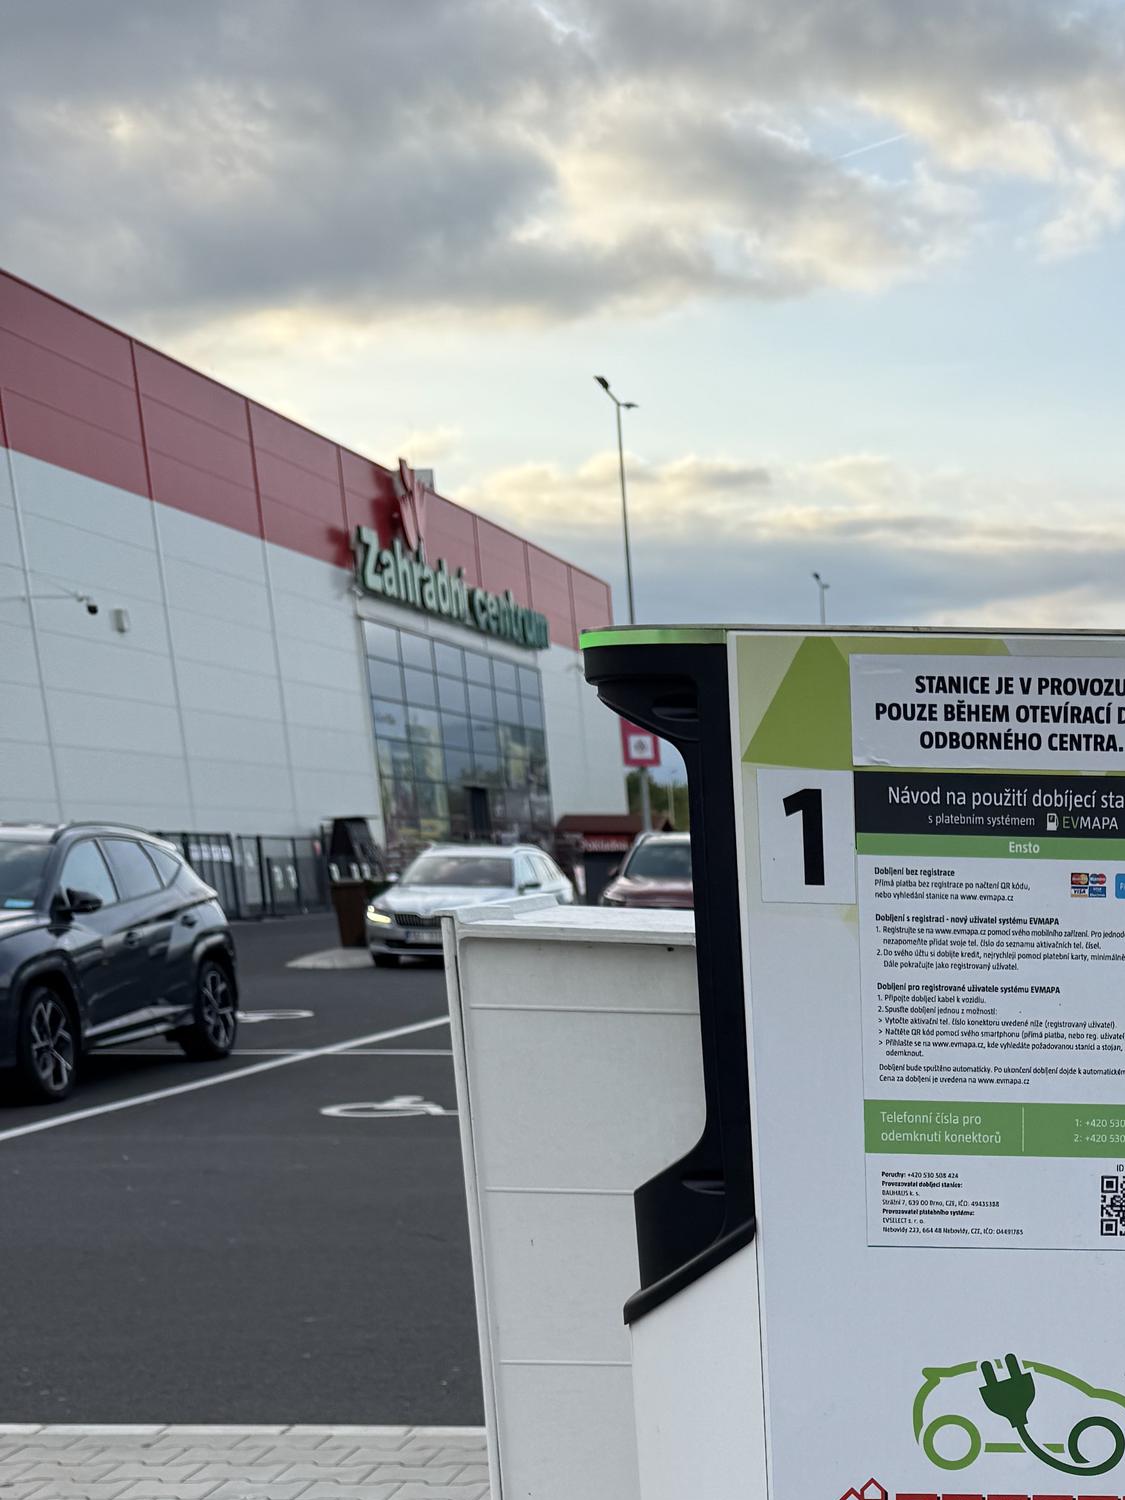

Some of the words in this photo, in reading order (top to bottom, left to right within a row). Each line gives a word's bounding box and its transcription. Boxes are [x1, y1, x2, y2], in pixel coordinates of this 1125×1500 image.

[356, 526, 472, 626] Zahradní
[915, 675, 990, 695] STANICE
[995, 676, 1014, 695] JE
[1019, 677, 1032, 695] V
[875, 702, 938, 722] POUZE
[944, 699, 1010, 723] BĚHEM
[1015, 700, 1113, 724] OTEVÍRACÍ
[920, 728, 1042, 751] ODBORNÉHO
[1048, 733, 1124, 752] CENTRA.
[888, 785, 940, 805] Návod
[946, 791, 966, 805] na
[972, 787, 1028, 811] použití
[1032, 788, 1097, 812] dobíjecí
[928, 815, 933, 824] s
[935, 813, 984, 827] platebním
[987, 814, 1035, 828] systémem
[1063, 815, 1119, 830] EVMAPA
[783, 789, 825, 885] 1
[1009, 841, 1040, 854] Ensto
[874, 866, 904, 877] Dobíjení
[905, 867, 919, 876] bez
[919, 868, 955, 878] registrace
[874, 879, 894, 887] Přímá
[896, 879, 917, 888] platba
[918, 880, 930, 888] bez
[931, 881, 964, 890] registrace
[965, 882, 974, 890] po
[975, 881, 999, 889] načtení
[1000, 882, 1011, 890] QR
[1011, 882, 1030, 891] kódu,
[875, 890, 892, 899] nebo
[892, 891, 925, 900] vyhledání
[925, 892, 949, 900] stanice
[960, 894, 1014, 903] www.evmapa.cz
[875, 913, 905, 923] Dobíjení
[911, 914, 945, 924] registrací
[950, 915, 968, 925] nový
[969, 915, 997, 924] uživatel
[998, 916, 1028, 926] systému
[1029, 917, 1059, 925] EVMAPA
[883, 926, 916, 935] Registrujte
[934, 928, 986, 936] www.evmapa.cz
[987, 928, 1011, 937] pomocí
[1011, 928, 1030, 936] svého
[1091, 930, 1102, 938] Pro
[950, 939, 967, 948] svoje
[968, 939, 979, 947] tel.
[1036, 940, 1072, 949] aktivačních
[1073, 941, 1084, 949] tel.
[876, 948, 882, 956] 2.
[894, 949, 913, 957] svého
[1017, 952, 1042, 961] pomocí
[1042, 952, 1070, 961] platební
[1071, 953, 1089, 962] karty,
[883, 960, 899, 968] Dále
[900, 960, 934, 970] pokračujte
[935, 961, 950, 970] jako
[950, 961, 991, 971] registrovaný
[992, 962, 1019, 970] uživatel.
[877, 982, 906, 992] Dobíjení
[921, 983, 966, 993] registrované
[967, 984, 999, 993] uživatele
[1000, 985, 1029, 995] systému
[1030, 986, 1061, 994] EVMAPA
[937, 995, 955, 1003] kabel
[956, 995, 960, 1003] k
[877, 1005, 884, 1013] 2.
[910, 1006, 936, 1015] dobíjení
[937, 1006, 960, 1015] jednou
[911, 1028, 921, 1036] QR
[922, 1028, 934, 1036] kód
[935, 1029, 960, 1038] pomocí
[960, 1029, 980, 1037] svého
[980, 1030, 1020, 1039] smartphonu
[1044, 1031, 1067, 1040] platba,
[1086, 1033, 1099, 1041] reg.
[879, 1074, 895, 1082] Cena
[905, 1075, 931, 1084] dobíjení
[932, 1076, 938, 1084] je
[939, 1075, 967, 1084] uvedena
[977, 1078, 1030, 1086] www.evmapa.cz
[880, 1111, 933, 1124] Telefonní
[935, 1112, 959, 1124] čísla
[962, 1115, 981, 1127] pro
[1075, 1119, 1082, 1127] 1:
[1085, 1119, 1107, 1128] +420
[1109, 1119, 1125, 1128] 530
[881, 1129, 941, 1142] odemknutí
[944, 1130, 1001, 1144] konektorů
[1074, 1134, 1082, 1142] 2:
[1085, 1134, 1107, 1143] +420
[1109, 1134, 1125, 1143] 530
